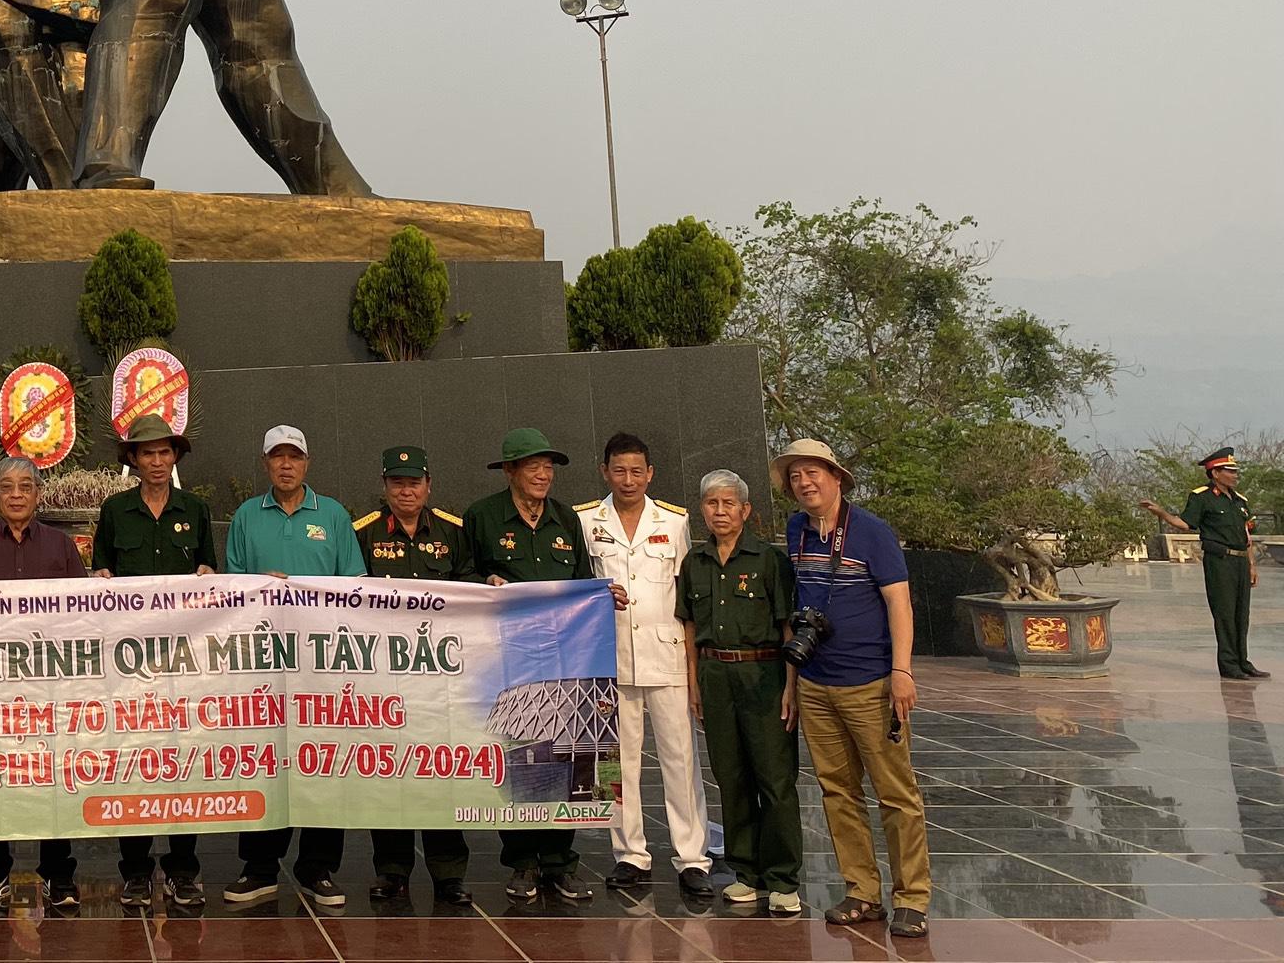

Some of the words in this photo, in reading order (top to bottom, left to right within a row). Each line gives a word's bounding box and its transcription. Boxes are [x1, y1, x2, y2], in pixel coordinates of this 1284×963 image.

[18, 596, 61, 615] BINH
[66, 589, 145, 613] PHƯỜNG
[150, 592, 176, 611] AN
[182, 587, 245, 610] KHÁNH
[260, 584, 318, 608] THÀNH
[324, 586, 364, 608] PHỐ
[368, 589, 402, 610] THỦ
[406, 590, 447, 612] ĐỨC
[114, 635, 200, 682] QUA
[205, 620, 299, 673] MIỀN
[306, 626, 378, 673] TÂY
[386, 620, 463, 674] BẮC
[65, 699, 106, 735] 70
[113, 691, 190, 733] NĂM
[196, 684, 286, 729] CHIẾN
[291, 682, 406, 728] THẮNG
[63, 741, 278, 793] (07/05/1954
[296, 742, 506, 787] 07/05/2024)
[101, 800, 124, 820] 20
[139, 795, 248, 819] 24/04/2024
[455, 805, 480, 822] ĐƠN
[483, 807, 496, 825] VỊ
[500, 801, 514, 823] TỔ
[518, 805, 549, 822] CHỨC
